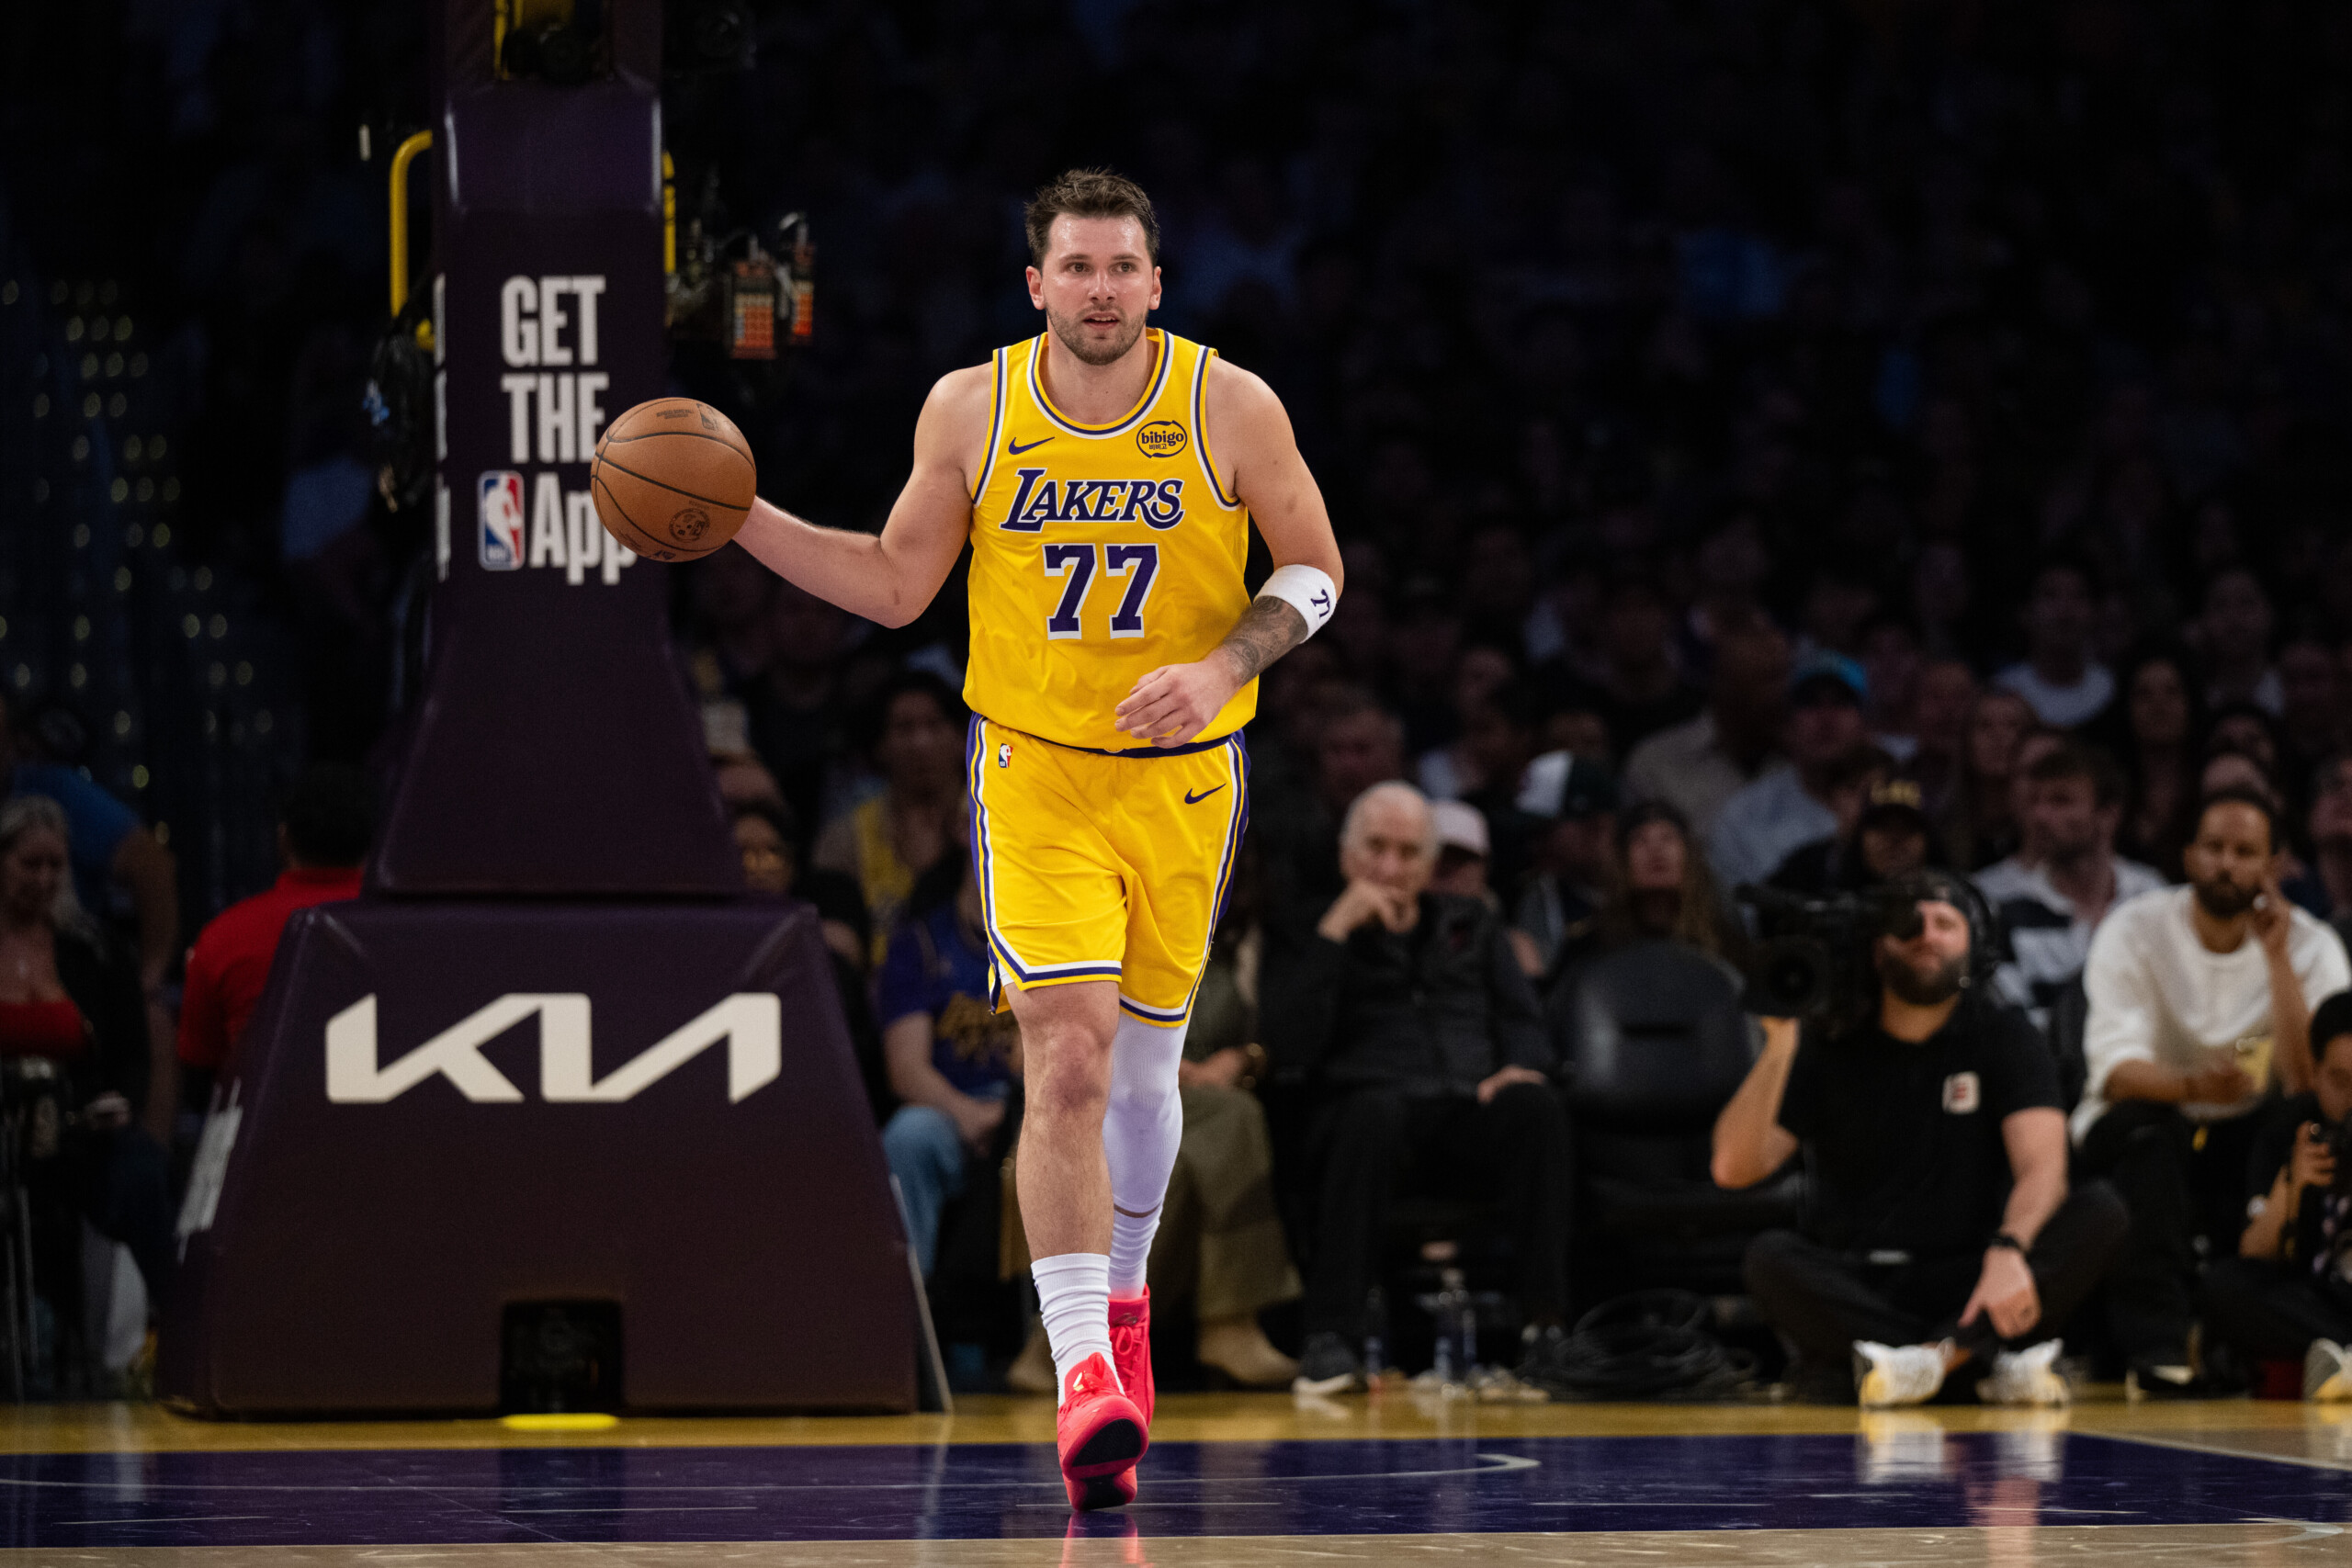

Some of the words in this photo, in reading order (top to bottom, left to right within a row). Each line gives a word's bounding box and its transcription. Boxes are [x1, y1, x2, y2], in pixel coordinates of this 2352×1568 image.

[501, 276, 606, 367] GET
[501, 373, 609, 463] THE
[1141, 430, 1184, 446] bibigo
[1000, 467, 1185, 533] LAKERS
[1041, 542, 1161, 640] 77
[1310, 588, 1330, 620] 77
[325, 992, 783, 1106] KIA
